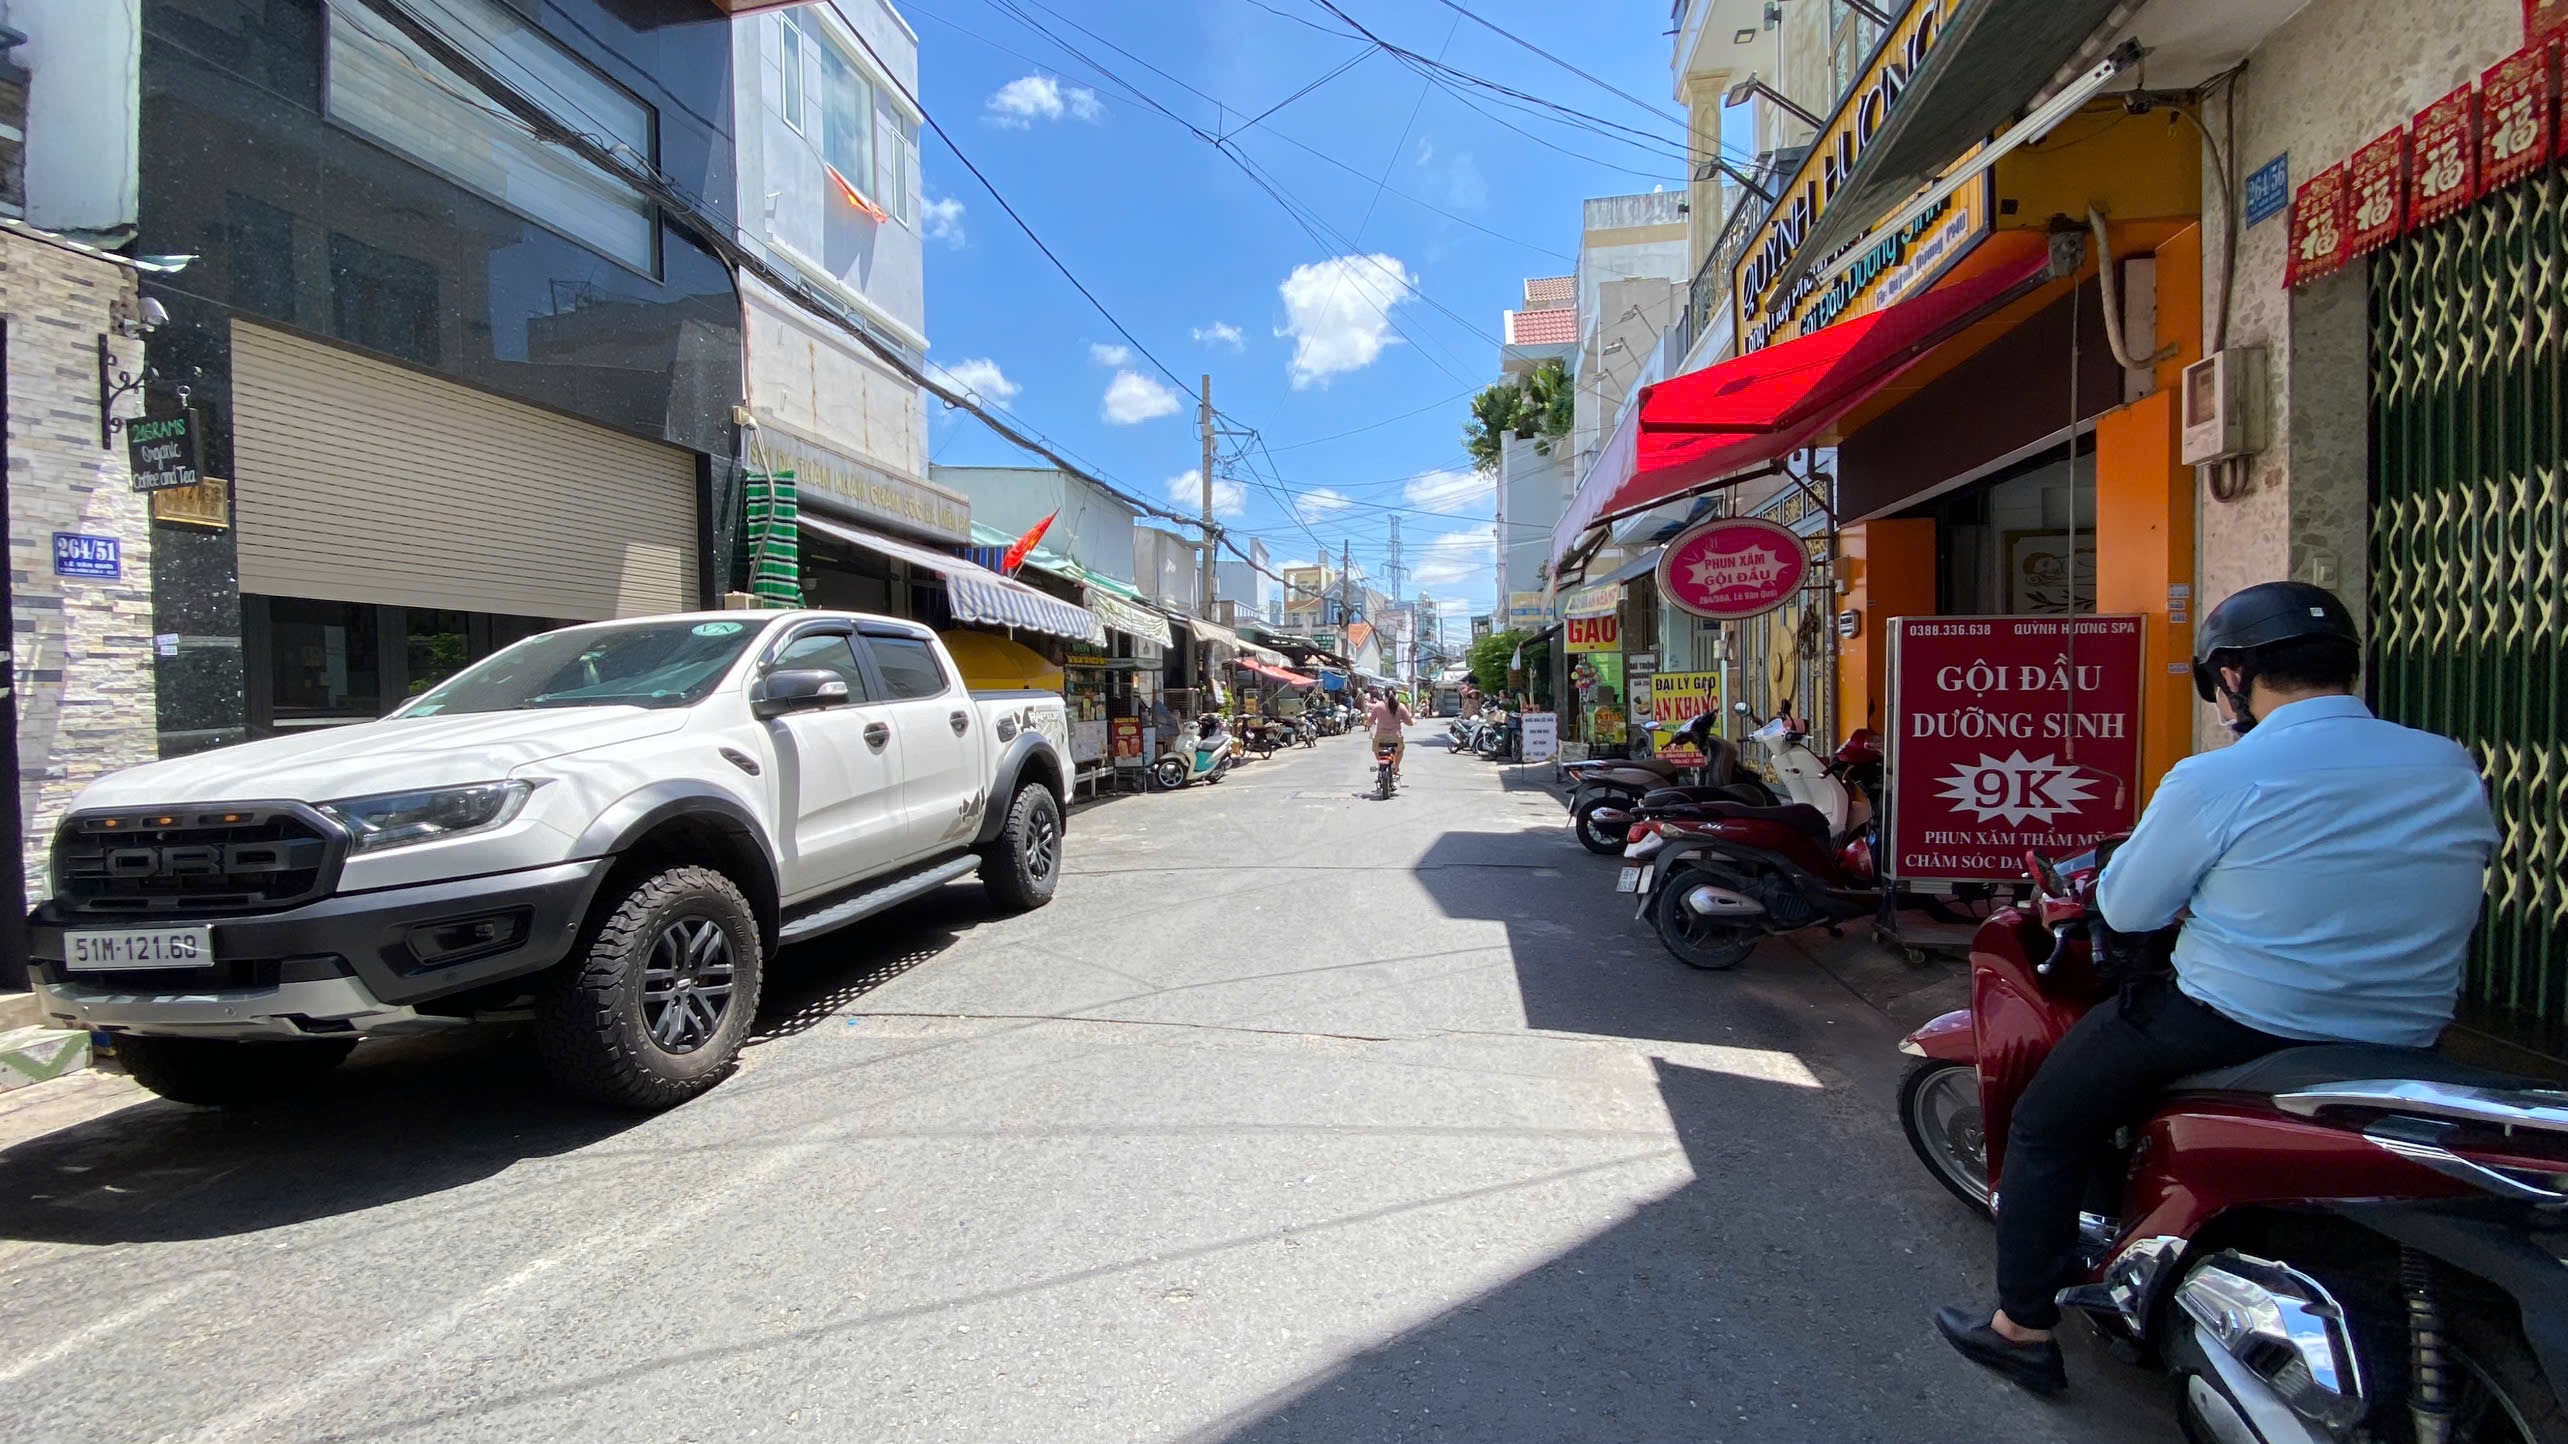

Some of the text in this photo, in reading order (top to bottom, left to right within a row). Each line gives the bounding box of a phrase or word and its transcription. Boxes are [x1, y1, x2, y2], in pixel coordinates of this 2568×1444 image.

[2491, 94, 2538, 160] 福
[2421, 136, 2464, 197] 福
[2356, 174, 2393, 231] 福
[2301, 208, 2339, 260] 福
[1743, 180, 1812, 321] QUỲNH
[142, 441, 181, 470] Organic
[133, 464, 196, 489] Coffee and Tea
[58, 537, 116, 561] 264/51
[1704, 552, 1765, 570] PHUN XĂM
[1704, 566, 1770, 587] GỘI ĐẦU
[1568, 615, 1617, 650] GẠO
[1909, 620, 2135, 636] 0388.336.638 QUỲNH HƯƠNG SPA
[1656, 674, 1716, 693] ĐẠI LÝ GẠO
[1936, 652, 2103, 698] GỘI ĐẦU
[1654, 696, 1672, 721] AN
[1912, 706, 2126, 738] DƯỠNG SINH
[1973, 768, 2063, 809] 9K
[1925, 826, 2106, 847] PHUN XĂM THẨM MỸ
[1905, 852, 1957, 868] CHĂM
[1961, 854, 1996, 869] SÓC
[1999, 857, 2023, 870] DA
